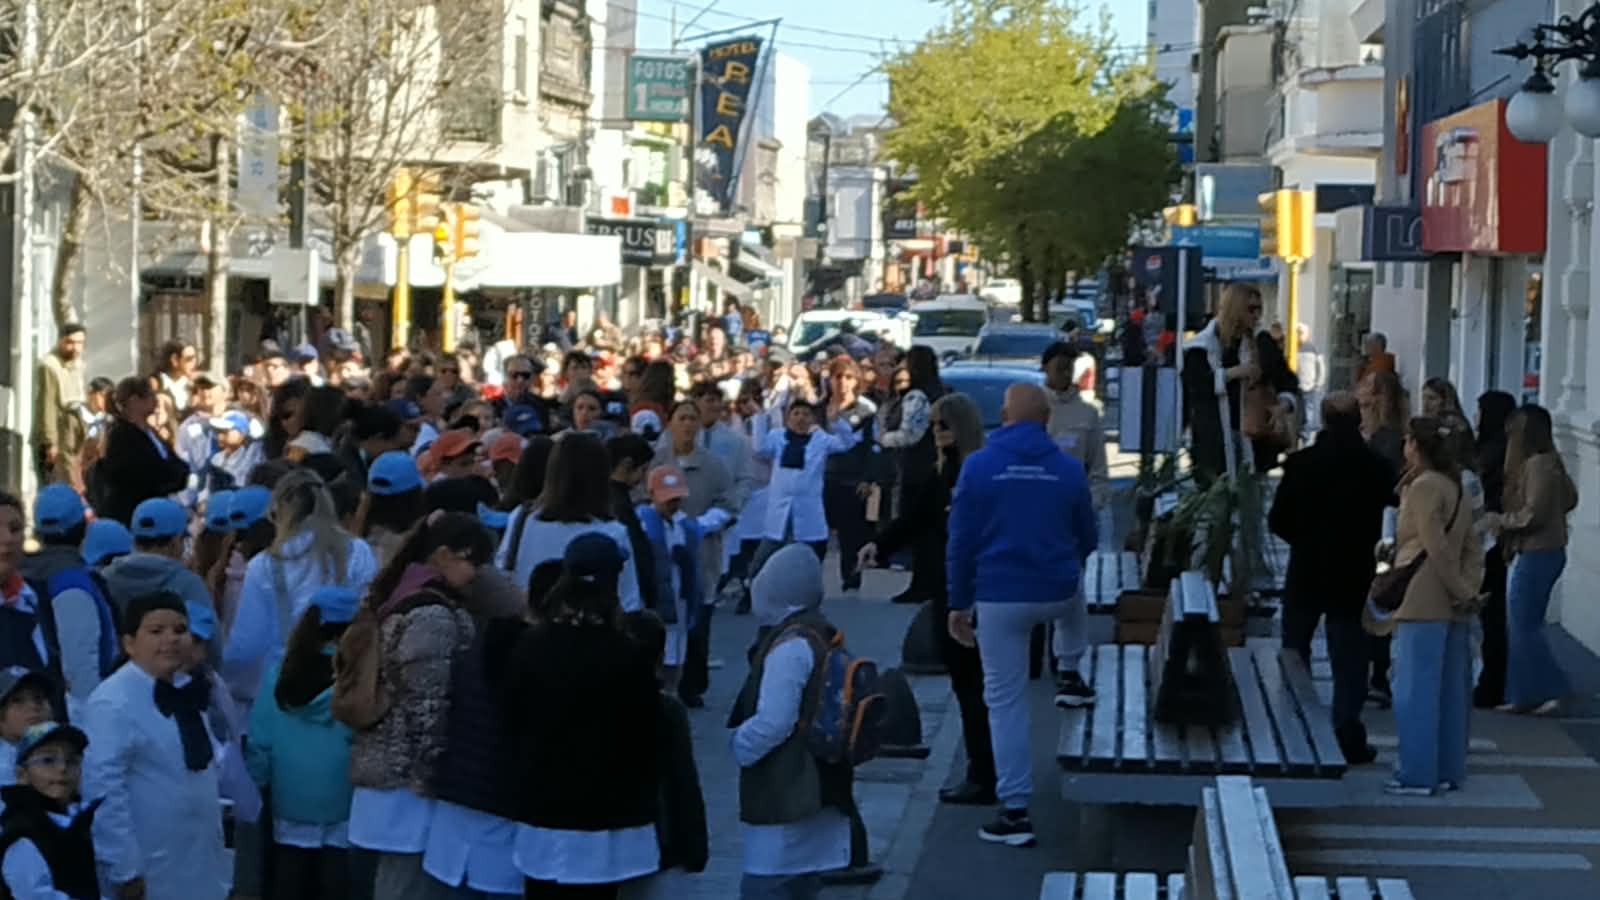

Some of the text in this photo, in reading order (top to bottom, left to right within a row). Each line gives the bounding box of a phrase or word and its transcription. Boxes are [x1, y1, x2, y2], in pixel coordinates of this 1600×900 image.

[709, 43, 757, 60] HOTEL
[634, 61, 687, 80] FOTOS
[635, 83, 649, 113] 1
